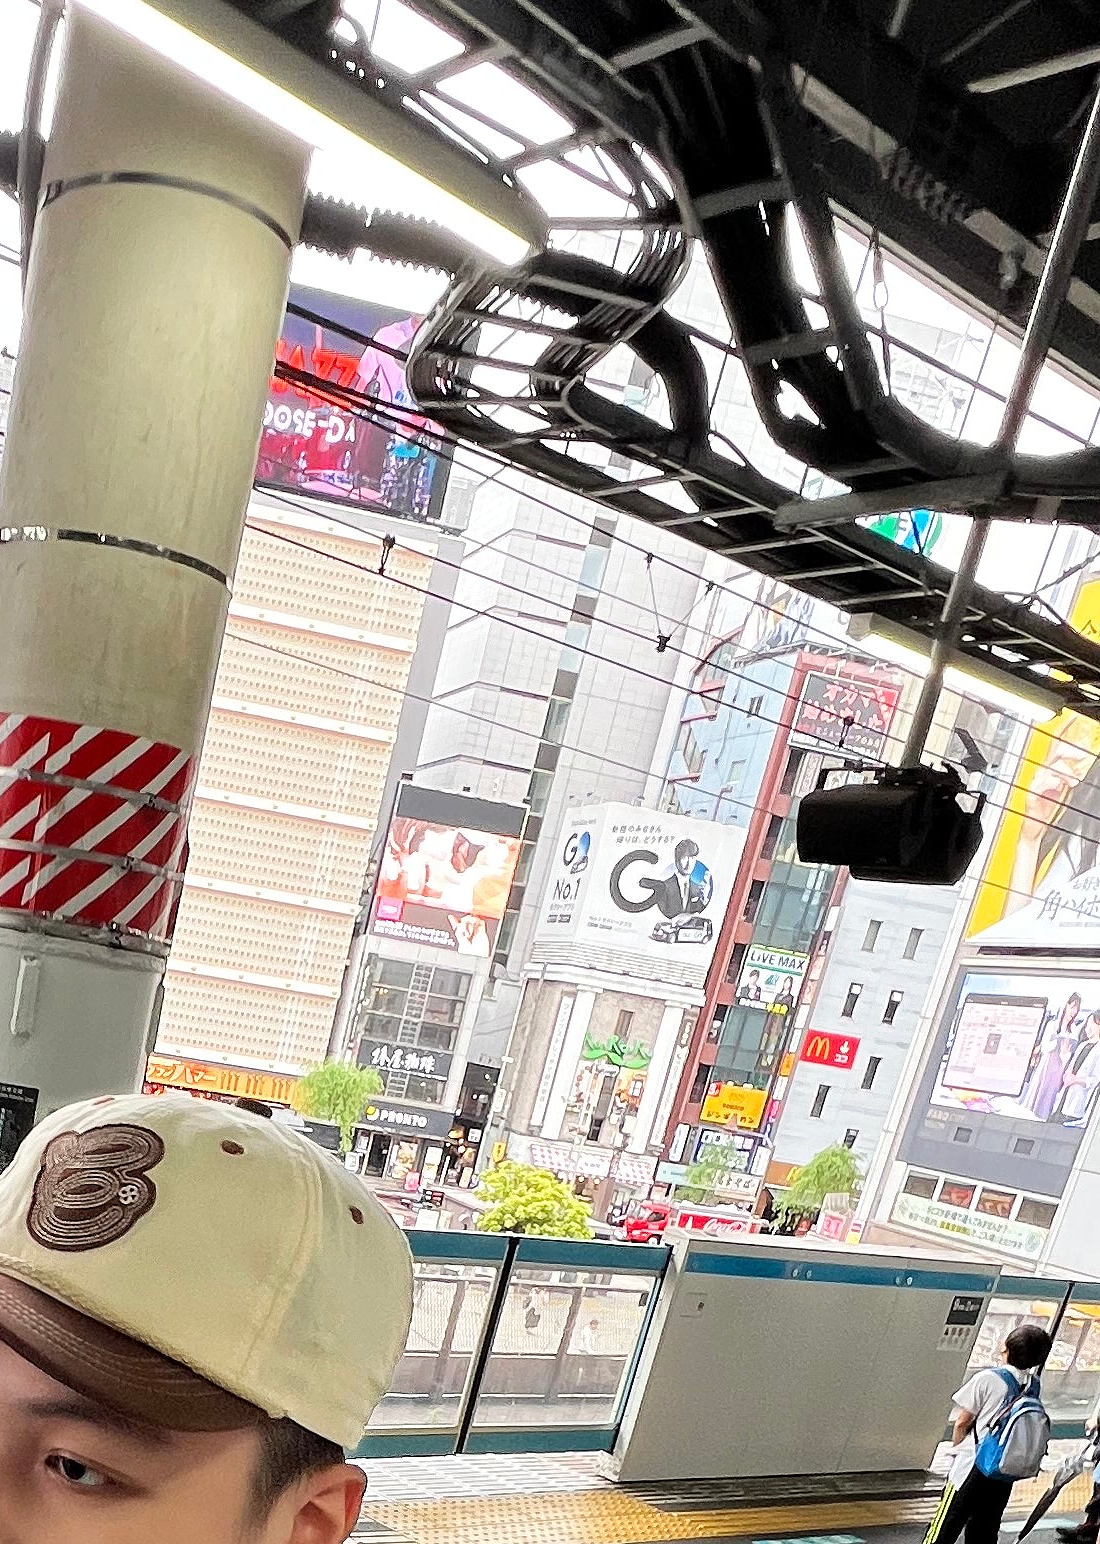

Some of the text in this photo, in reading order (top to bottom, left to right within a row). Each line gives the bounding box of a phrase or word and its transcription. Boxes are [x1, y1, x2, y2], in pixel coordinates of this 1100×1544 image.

[553, 878, 581, 900] No.1
[778, 956, 806, 971] MAX
[380, 1109, 428, 1128] PRONTO
[707, 1110, 755, 1124] ジンギカン
